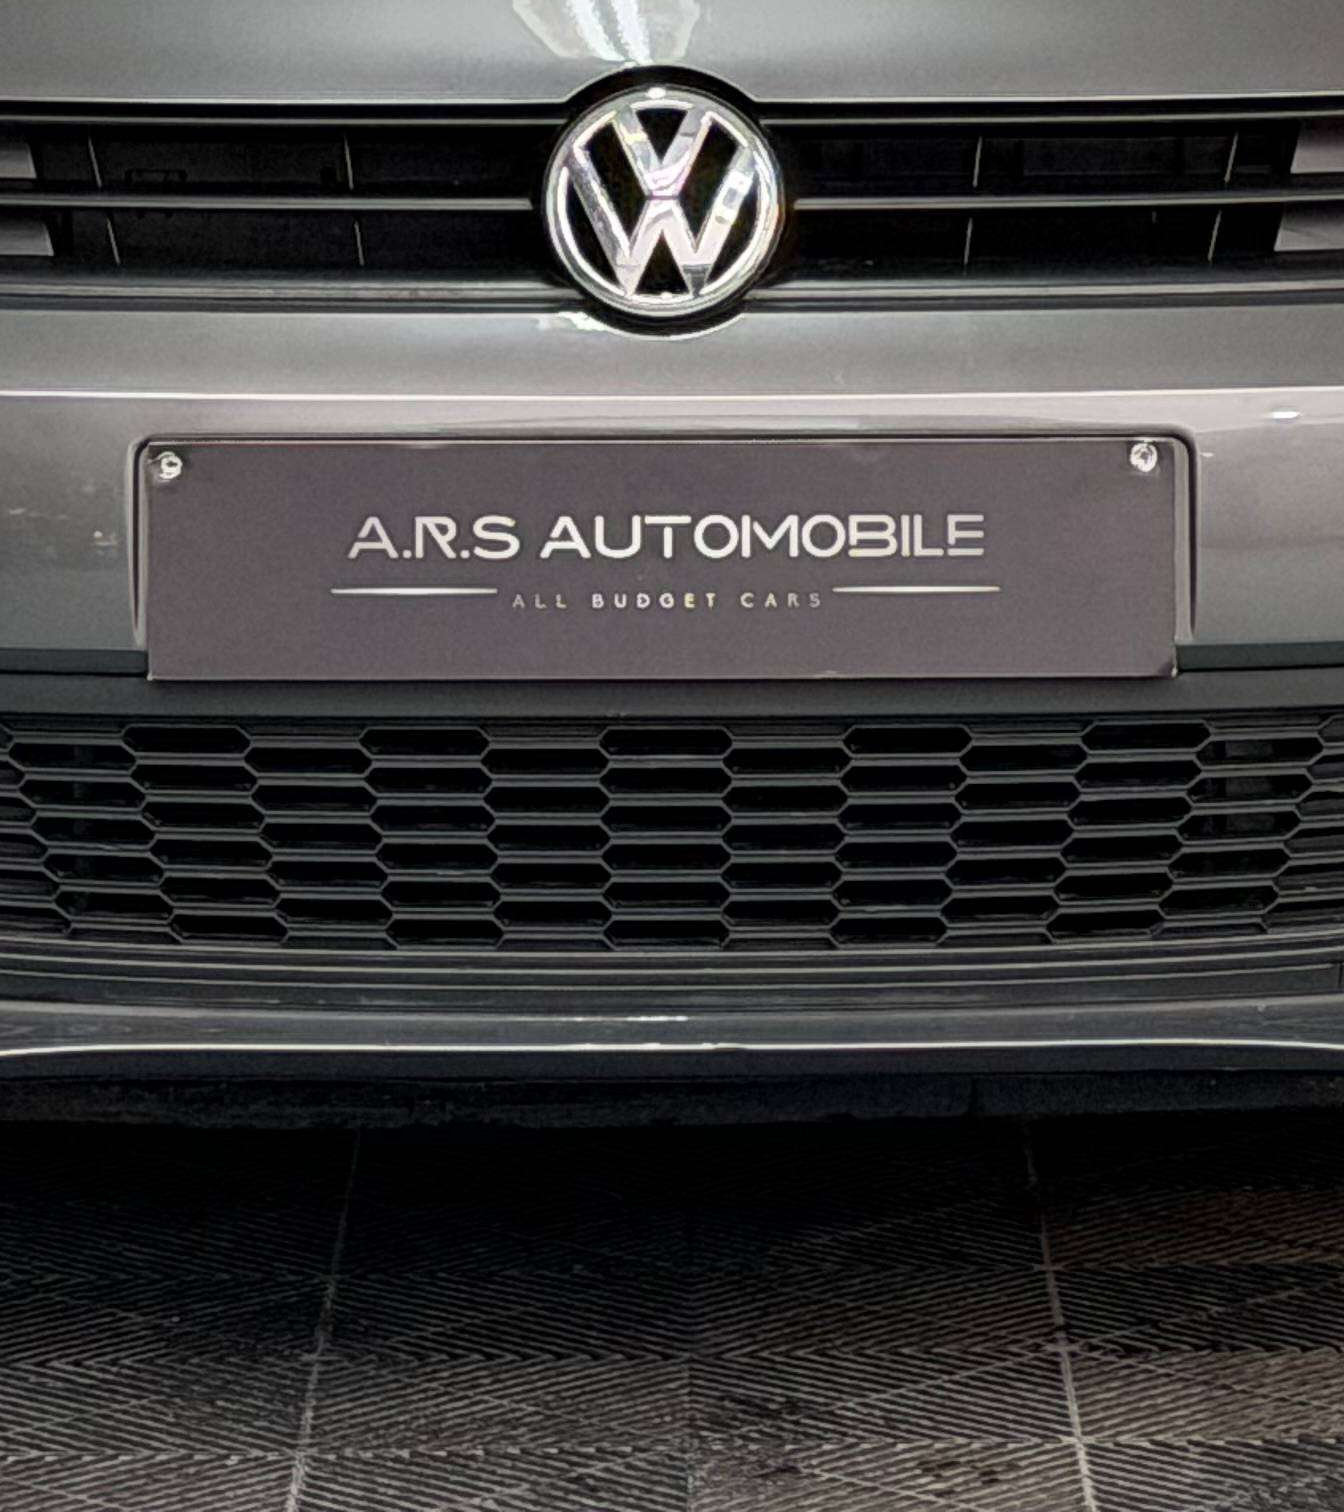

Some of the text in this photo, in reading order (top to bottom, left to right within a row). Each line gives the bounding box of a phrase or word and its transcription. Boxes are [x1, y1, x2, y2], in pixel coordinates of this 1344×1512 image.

[569, 100, 756, 299] VW
[348, 514, 984, 559] A.R.S AUTOMOBILE
[512, 592, 821, 609] ALL BUDGET CARS
